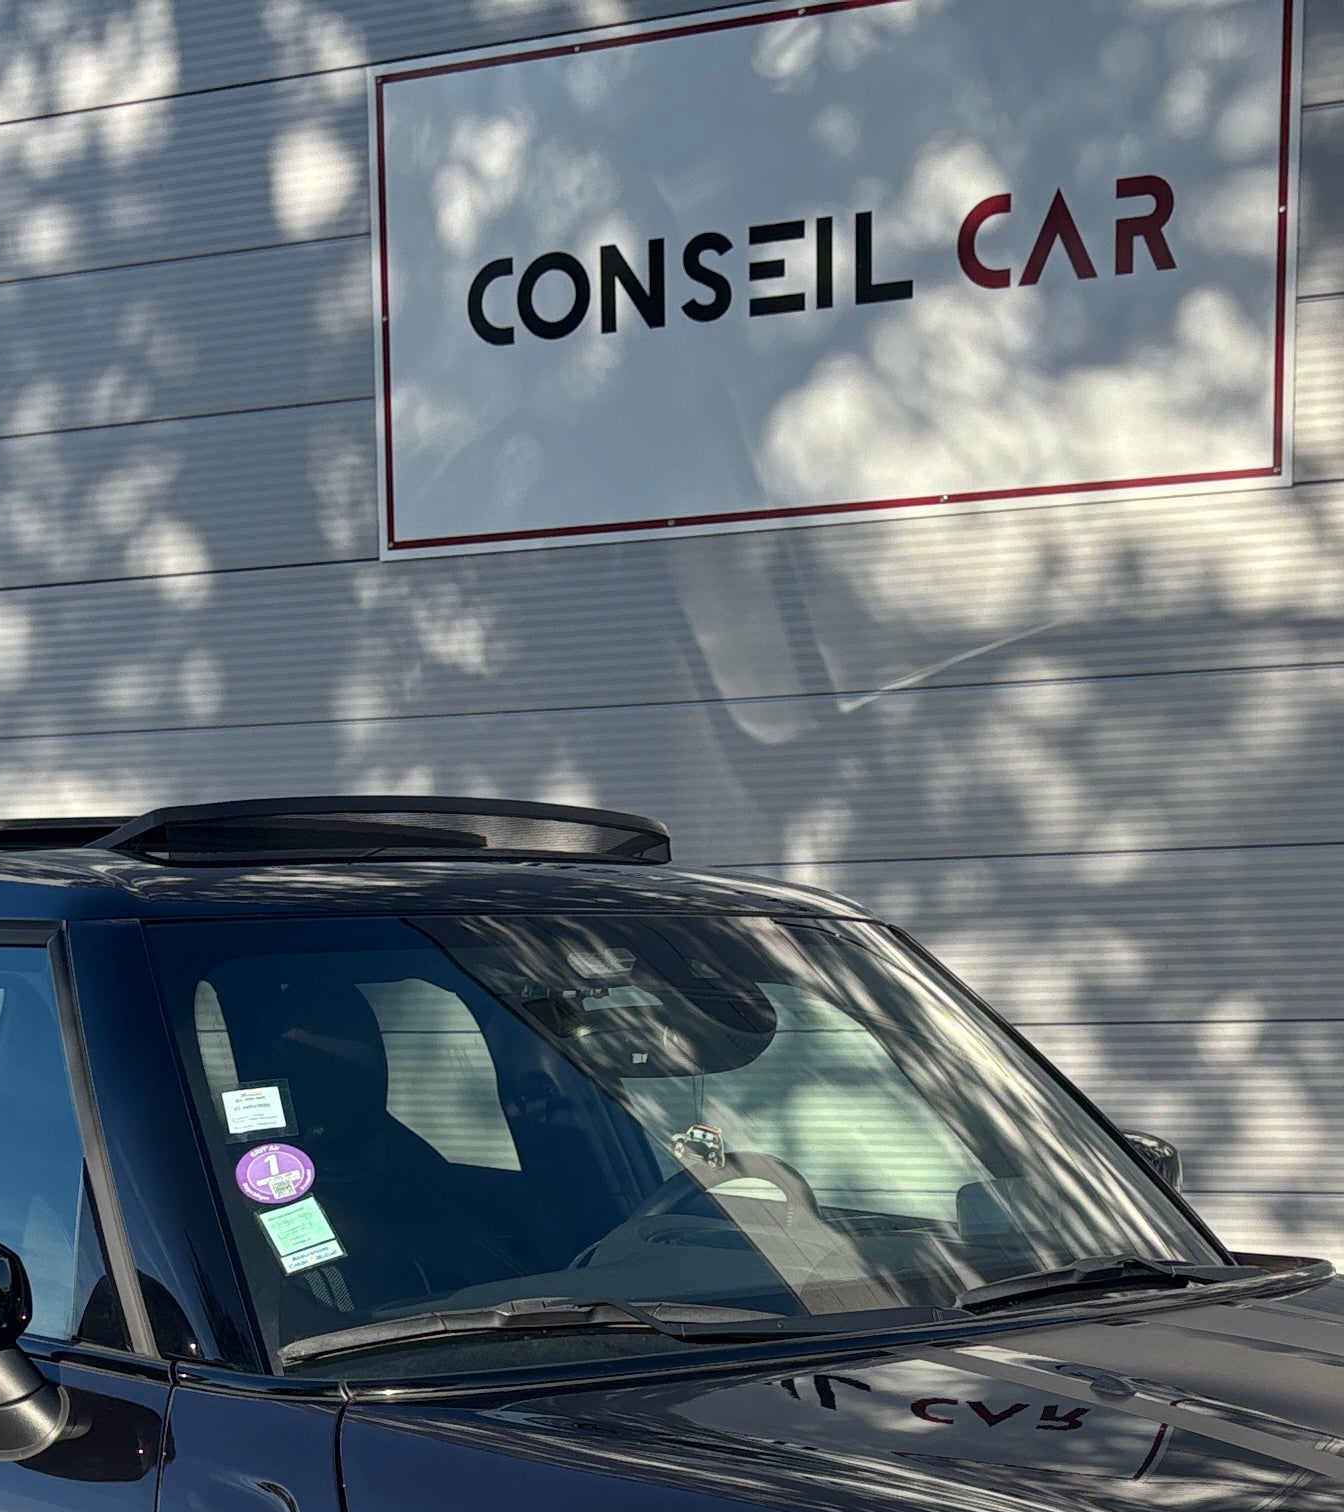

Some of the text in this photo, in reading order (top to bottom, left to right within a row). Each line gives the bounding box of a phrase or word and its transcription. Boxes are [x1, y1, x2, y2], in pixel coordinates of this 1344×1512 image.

[468, 174, 1177, 345] CONSEIL CAR
[263, 1154, 280, 1176] 1
